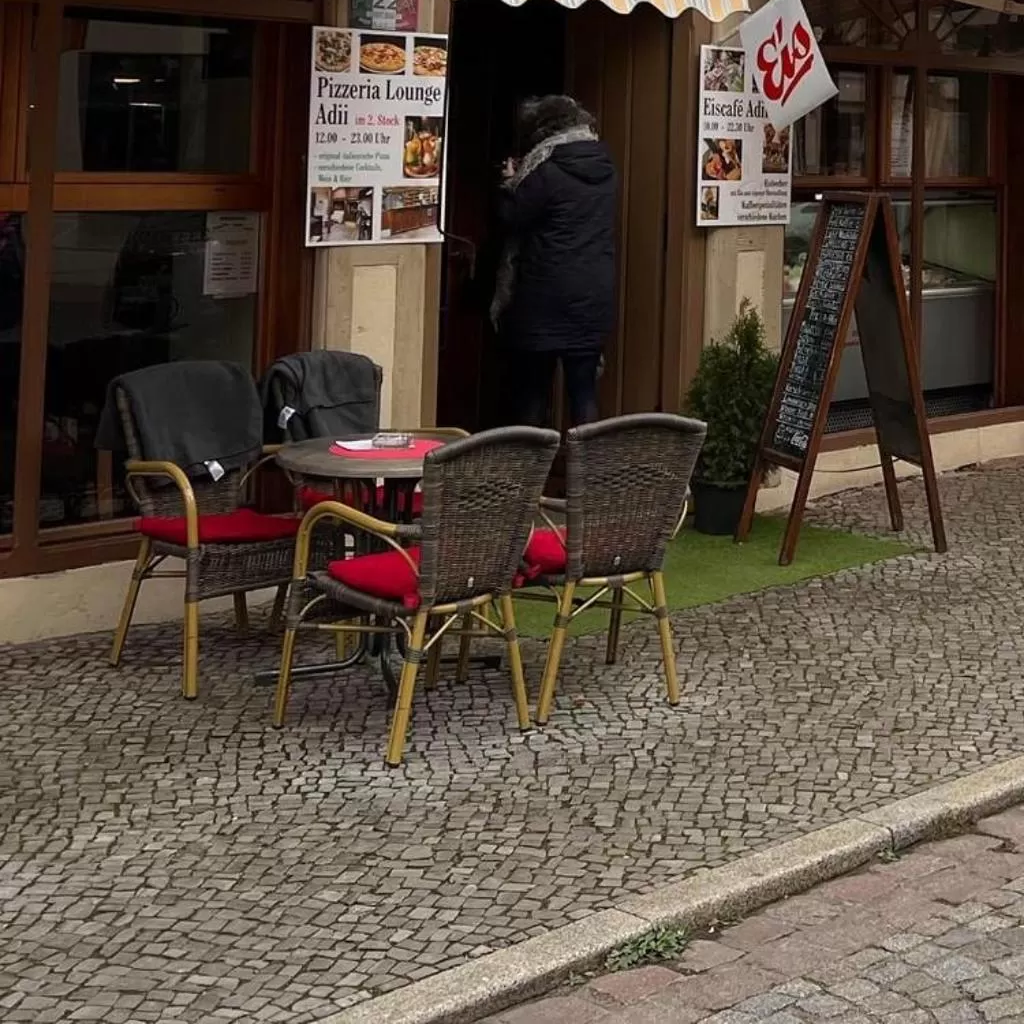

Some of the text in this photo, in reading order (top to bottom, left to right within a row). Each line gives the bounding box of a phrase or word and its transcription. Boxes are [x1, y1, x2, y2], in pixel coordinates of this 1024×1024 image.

[757, 16, 812, 102] Eis
[316, 76, 441, 106] Pizzeria Lounge
[315, 103, 349, 126] Adii
[377, 115, 399, 126] Stock
[703, 97, 743, 117] Eiscafé
[315, 131, 338, 144] 12.00
[350, 132, 374, 144] 23.00
[375, 132, 391, 144] Uhr
